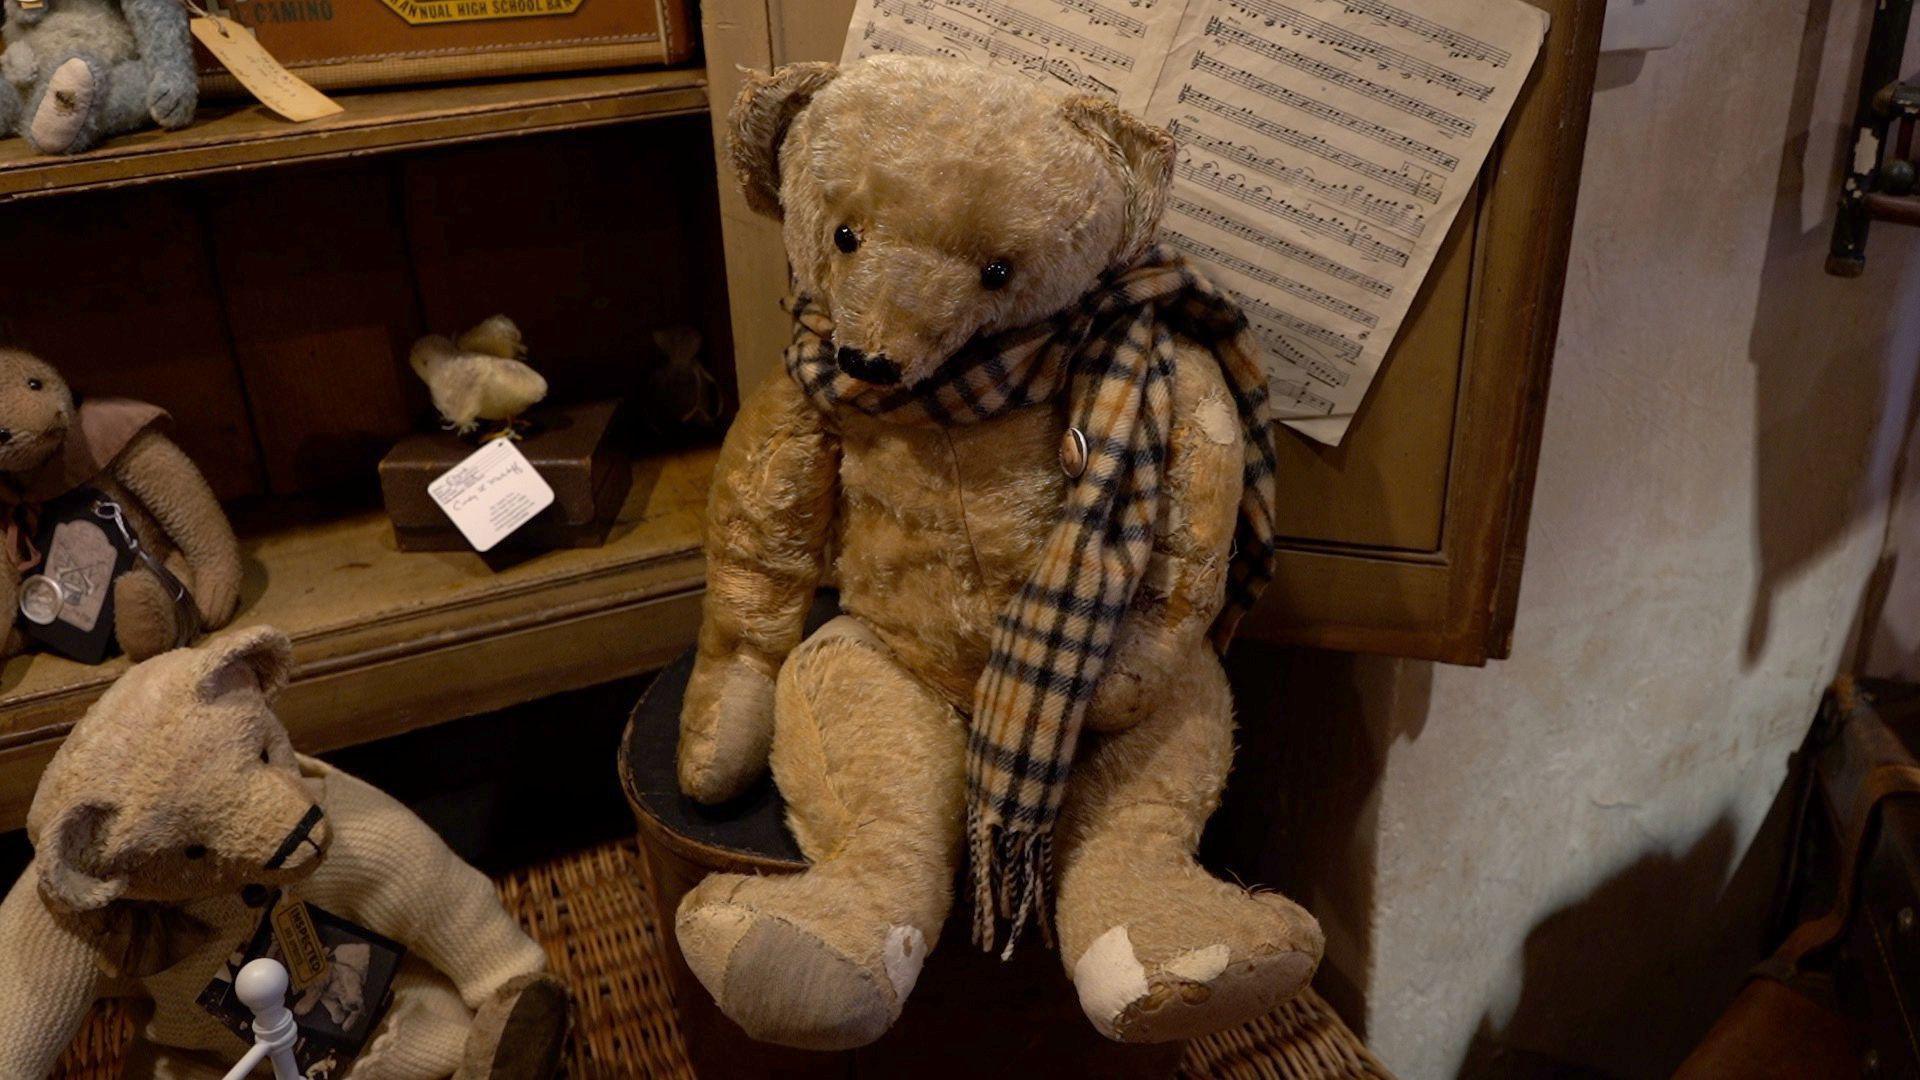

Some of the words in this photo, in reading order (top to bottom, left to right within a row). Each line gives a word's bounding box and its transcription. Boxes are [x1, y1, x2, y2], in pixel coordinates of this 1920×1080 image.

[255, 0, 332, 22] CAMINO
[399, 0, 455, 20] ANNUAL
[458, 2, 488, 18] HIGH
[491, 0, 543, 14] SCHOOL
[290, 907, 321, 972] INSPECTED
